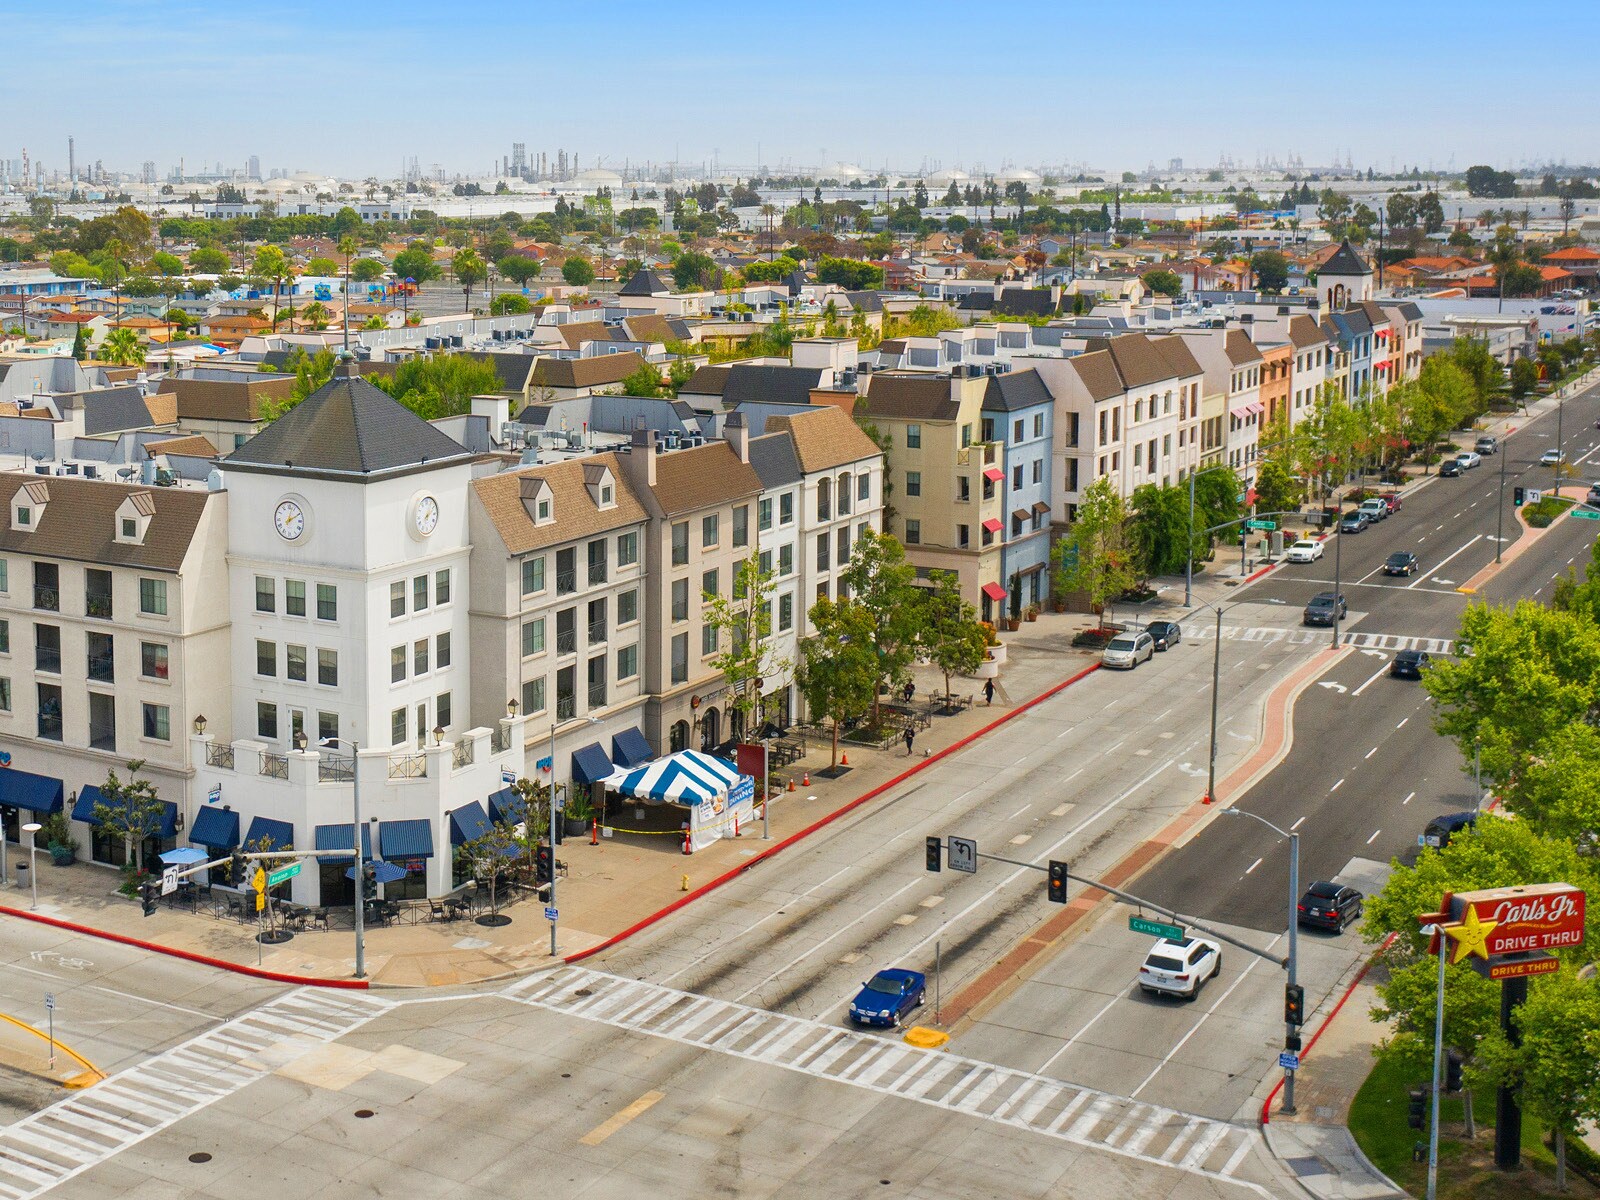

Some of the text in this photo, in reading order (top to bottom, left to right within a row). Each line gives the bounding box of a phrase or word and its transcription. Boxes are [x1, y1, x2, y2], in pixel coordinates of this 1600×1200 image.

[1493, 895, 1578, 926] Carl's Jr.
[1133, 920, 1161, 933] Carson
[1495, 930, 1580, 951] DRIVE THRU
[1492, 961, 1557, 976] DRIVE THRU
